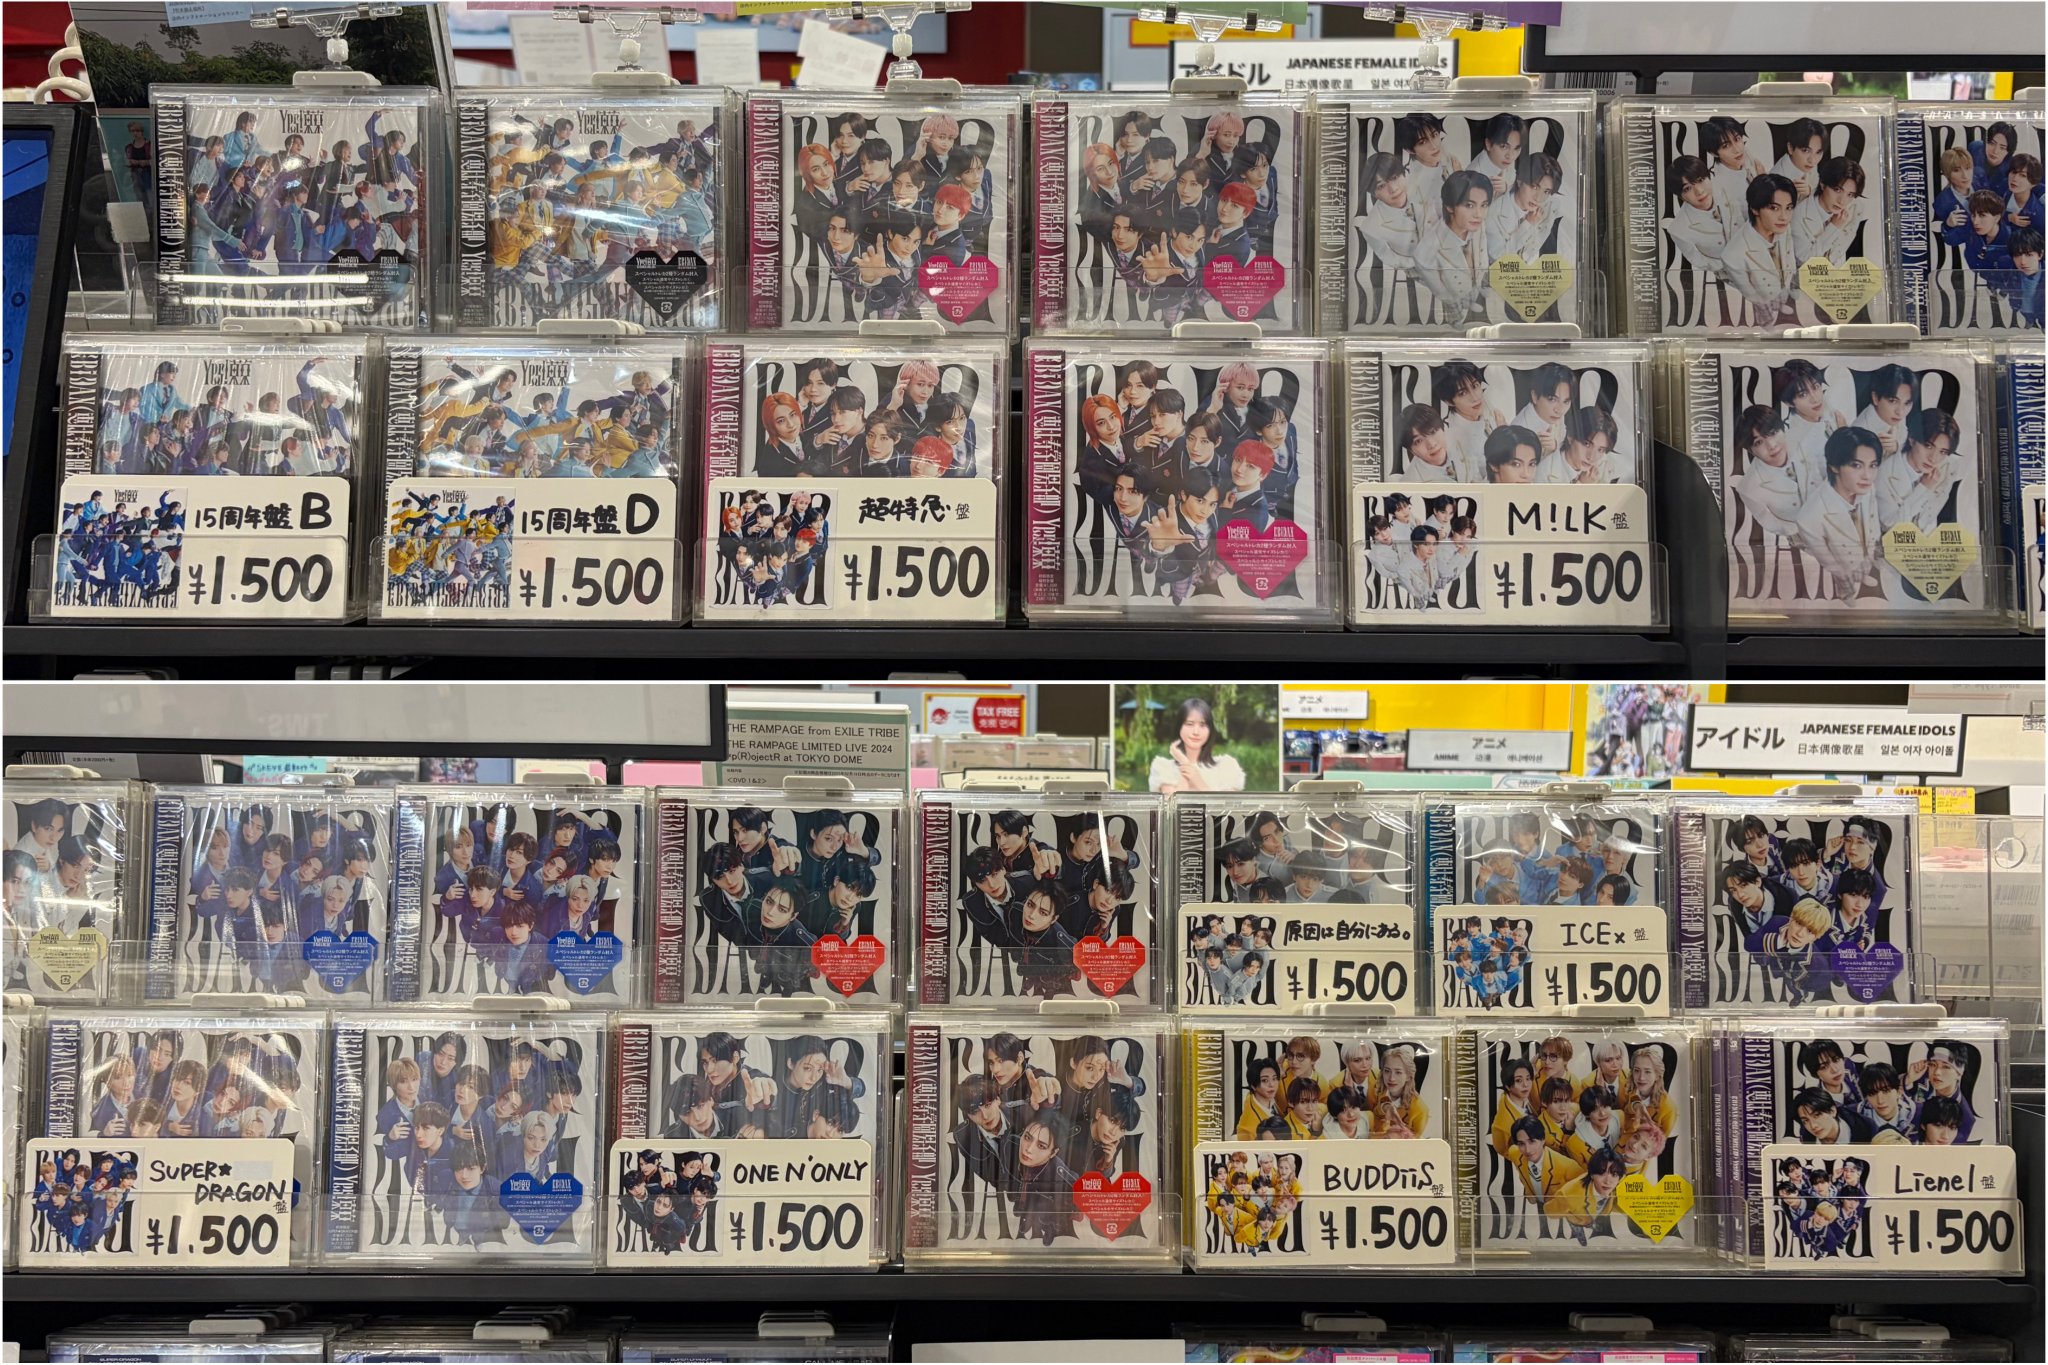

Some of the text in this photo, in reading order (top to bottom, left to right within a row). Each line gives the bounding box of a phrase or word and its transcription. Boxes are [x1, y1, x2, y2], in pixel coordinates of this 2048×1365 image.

[1286, 57, 1352, 70] JAPANESE
[1354, 57, 1408, 69] FEMALE
[194, 492, 332, 530] 15周年盤 B
[521, 493, 659, 535] 15周年盤 D
[858, 494, 951, 524] 超特急
[1508, 502, 1607, 535] M!LK
[976, 706, 1021, 718] TAX FREE
[727, 723, 900, 738] THE RAMPAGE from EXILE TRIBE
[1800, 722, 1956, 737] JAPANESE FEMALE IDOLS
[1472, 737, 1507, 749] アニメ
[1696, 726, 1785, 750] アイドル
[727, 740, 893, 753] THE RAMPAGE LIMITED LIVE 2024
[1798, 743, 1864, 756] 日本偶像歌星
[1880, 744, 1954, 757] 일본 여자 아이돌
[784, 753, 793, 761] at
[797, 753, 830, 763] TOKYO
[833, 755, 862, 764] DOME
[1434, 754, 1459, 762] ANIME
[1283, 920, 1411, 946] 原因は自分にある。
[733, 1163, 779, 1184] ONE
[195, 1180, 286, 1205] DRAGON
